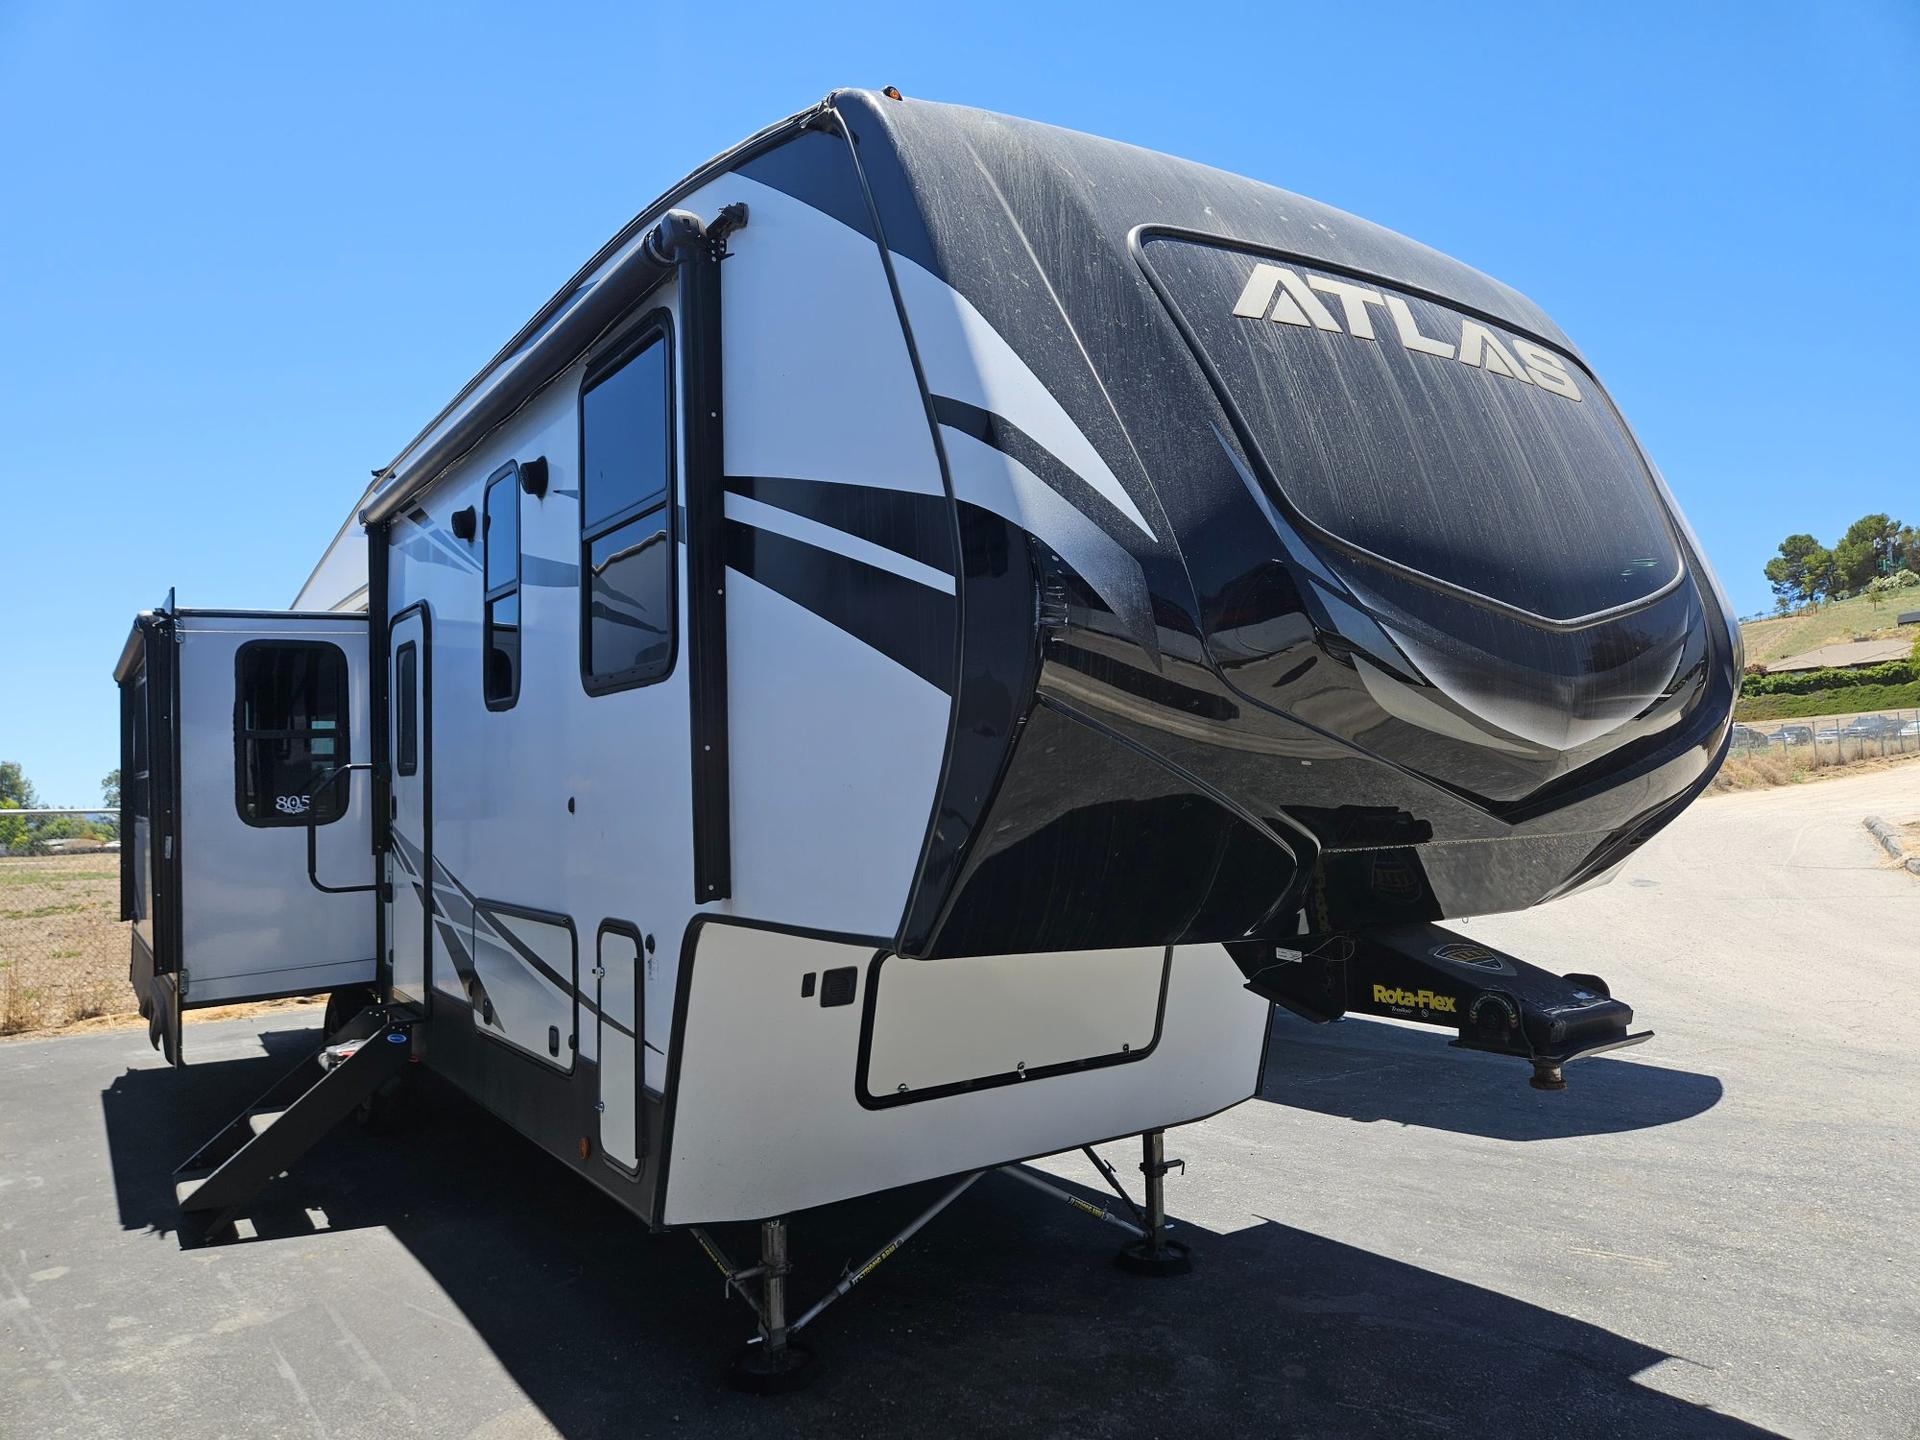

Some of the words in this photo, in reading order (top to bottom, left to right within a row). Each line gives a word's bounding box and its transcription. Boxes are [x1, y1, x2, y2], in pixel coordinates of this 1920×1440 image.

[1233, 263, 1582, 402] ATLAS
[275, 795, 311, 812] 805
[1373, 984, 1457, 1013] Rota-Flex
